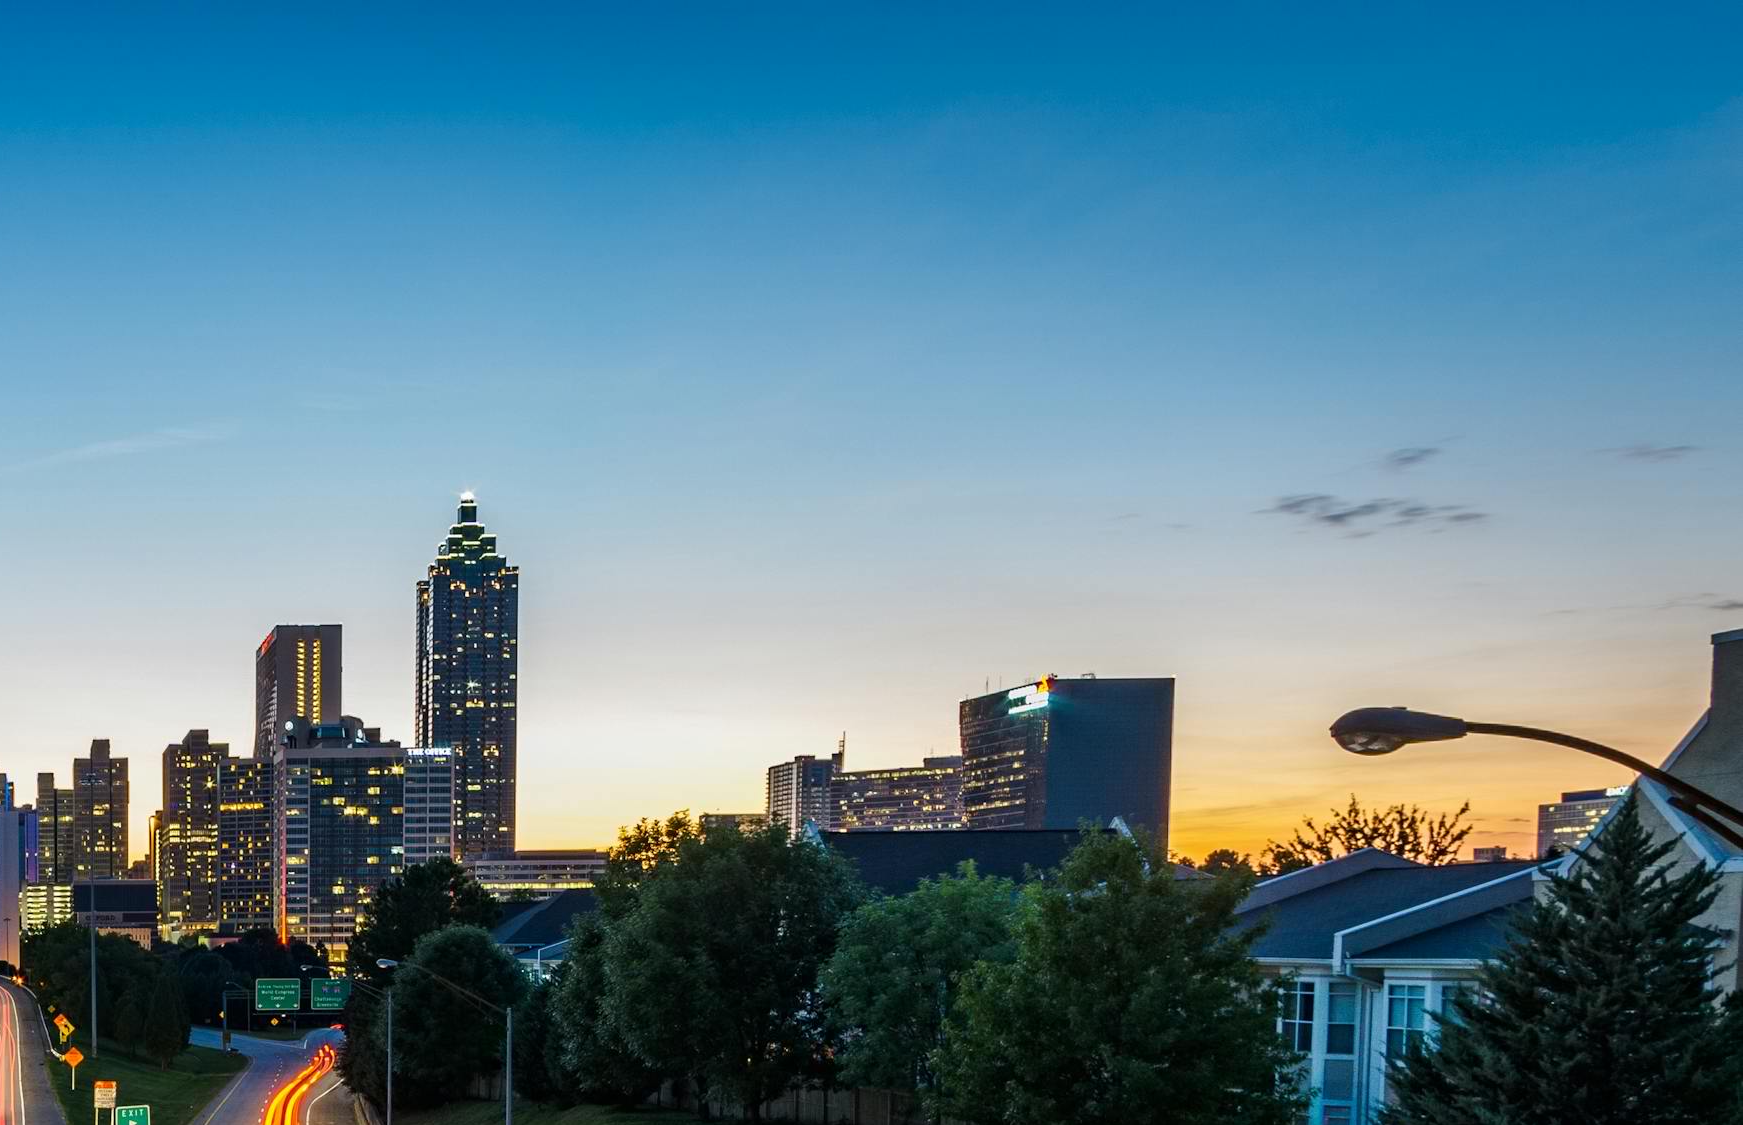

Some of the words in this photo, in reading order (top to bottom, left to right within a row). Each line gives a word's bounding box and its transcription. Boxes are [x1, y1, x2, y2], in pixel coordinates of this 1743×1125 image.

[407, 748, 424, 756] THE
[424, 748, 452, 756] OFFICE
[122, 1109, 143, 1117] EXIT
